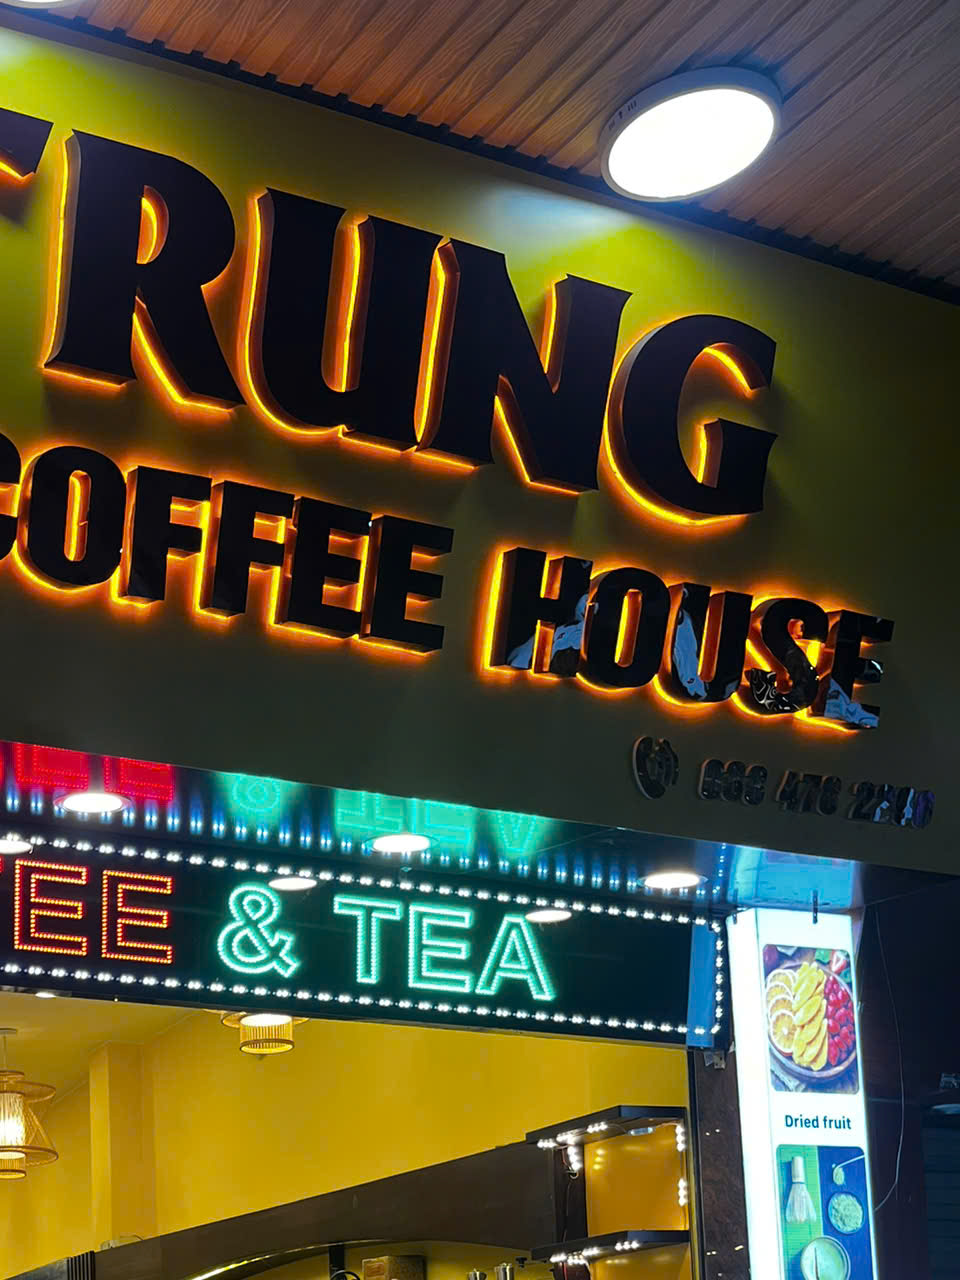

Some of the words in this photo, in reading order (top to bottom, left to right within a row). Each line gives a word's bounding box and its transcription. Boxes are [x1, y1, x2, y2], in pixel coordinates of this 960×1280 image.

[480, 544, 895, 732] HOUSE
[216, 883, 298, 979] &
[333, 894, 556, 1002] TEA
[784, 1114, 819, 1129] Dried
[821, 1114, 852, 1130] fruit
